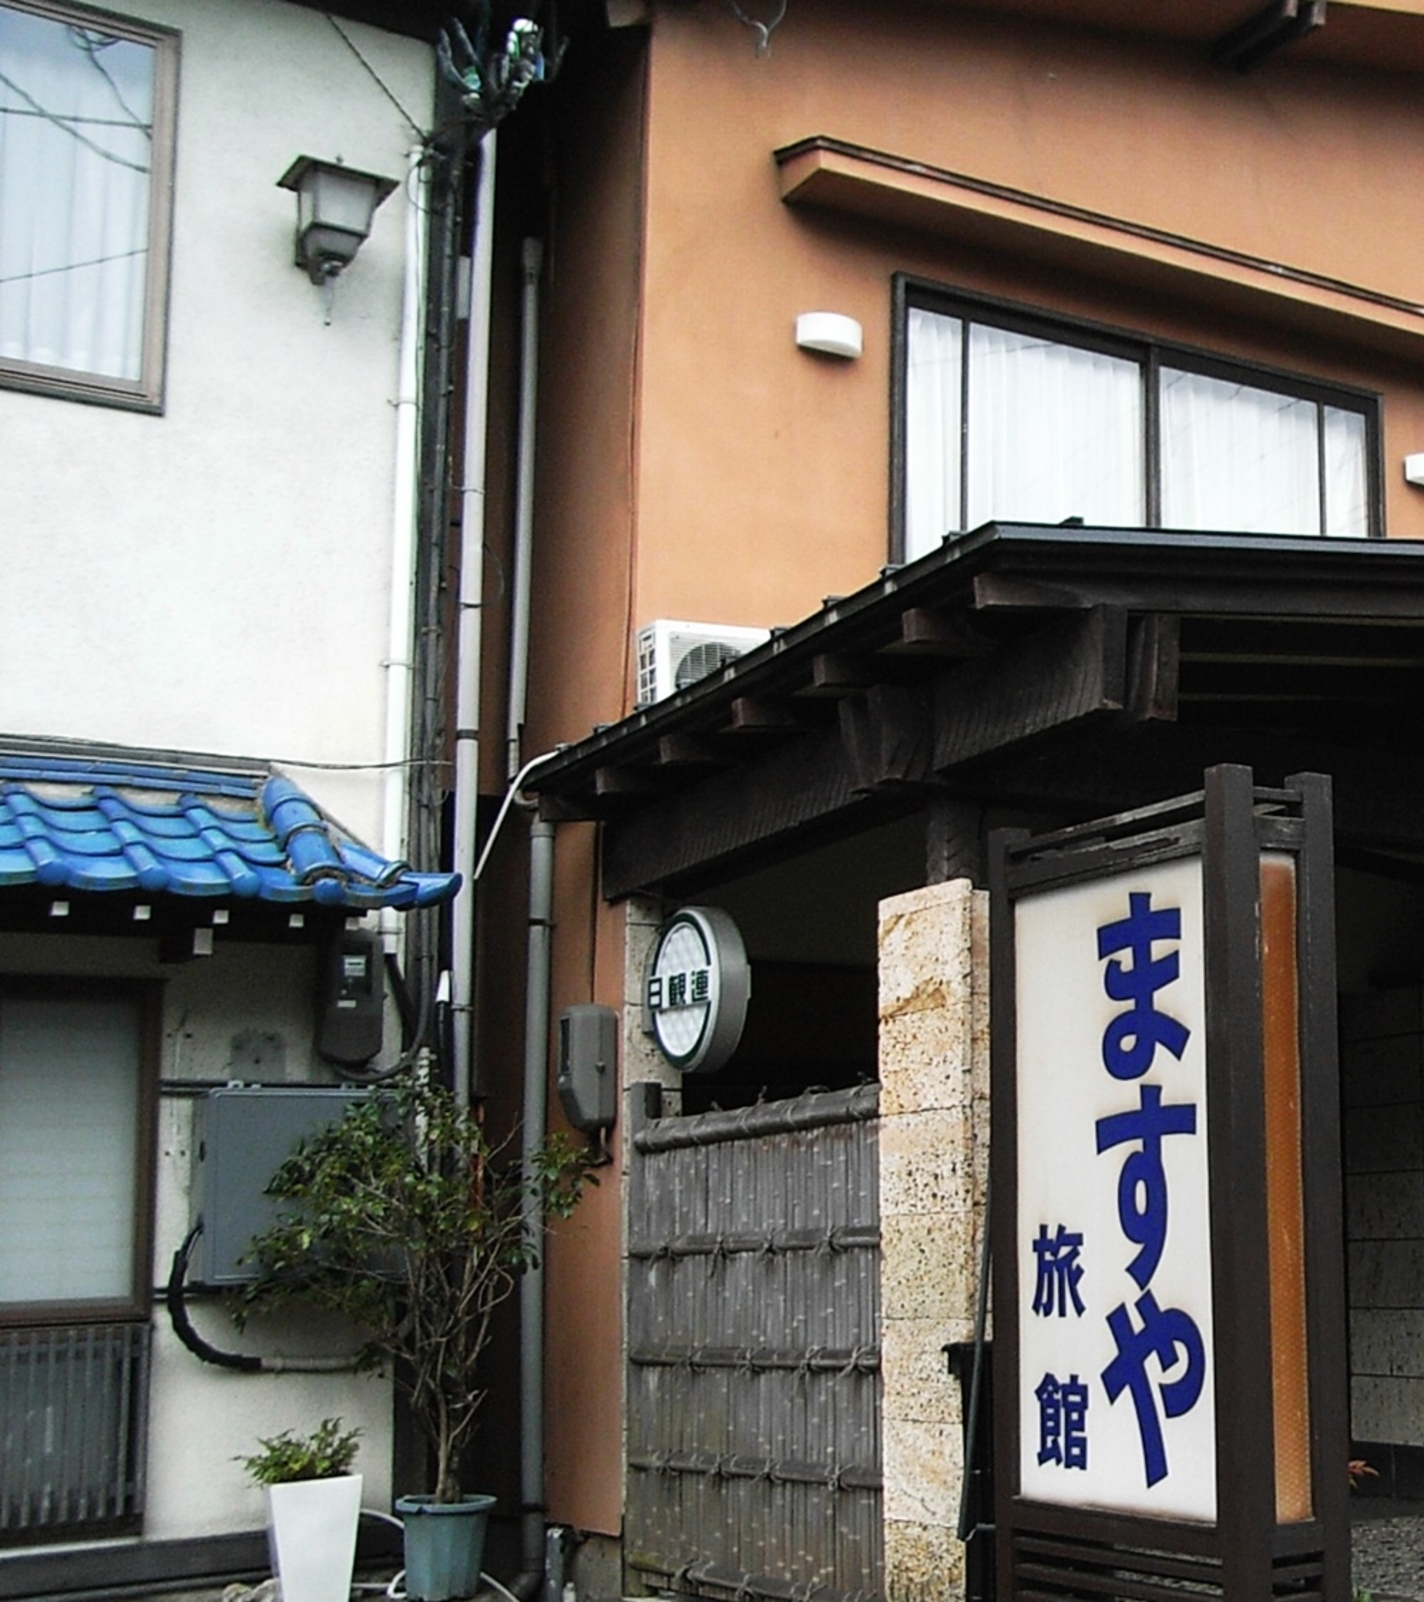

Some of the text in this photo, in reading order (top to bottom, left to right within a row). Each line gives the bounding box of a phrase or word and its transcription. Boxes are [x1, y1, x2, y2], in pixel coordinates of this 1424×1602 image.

[1032, 1224, 1089, 1471] 旅館
[1095, 892, 1205, 1488] ますや
